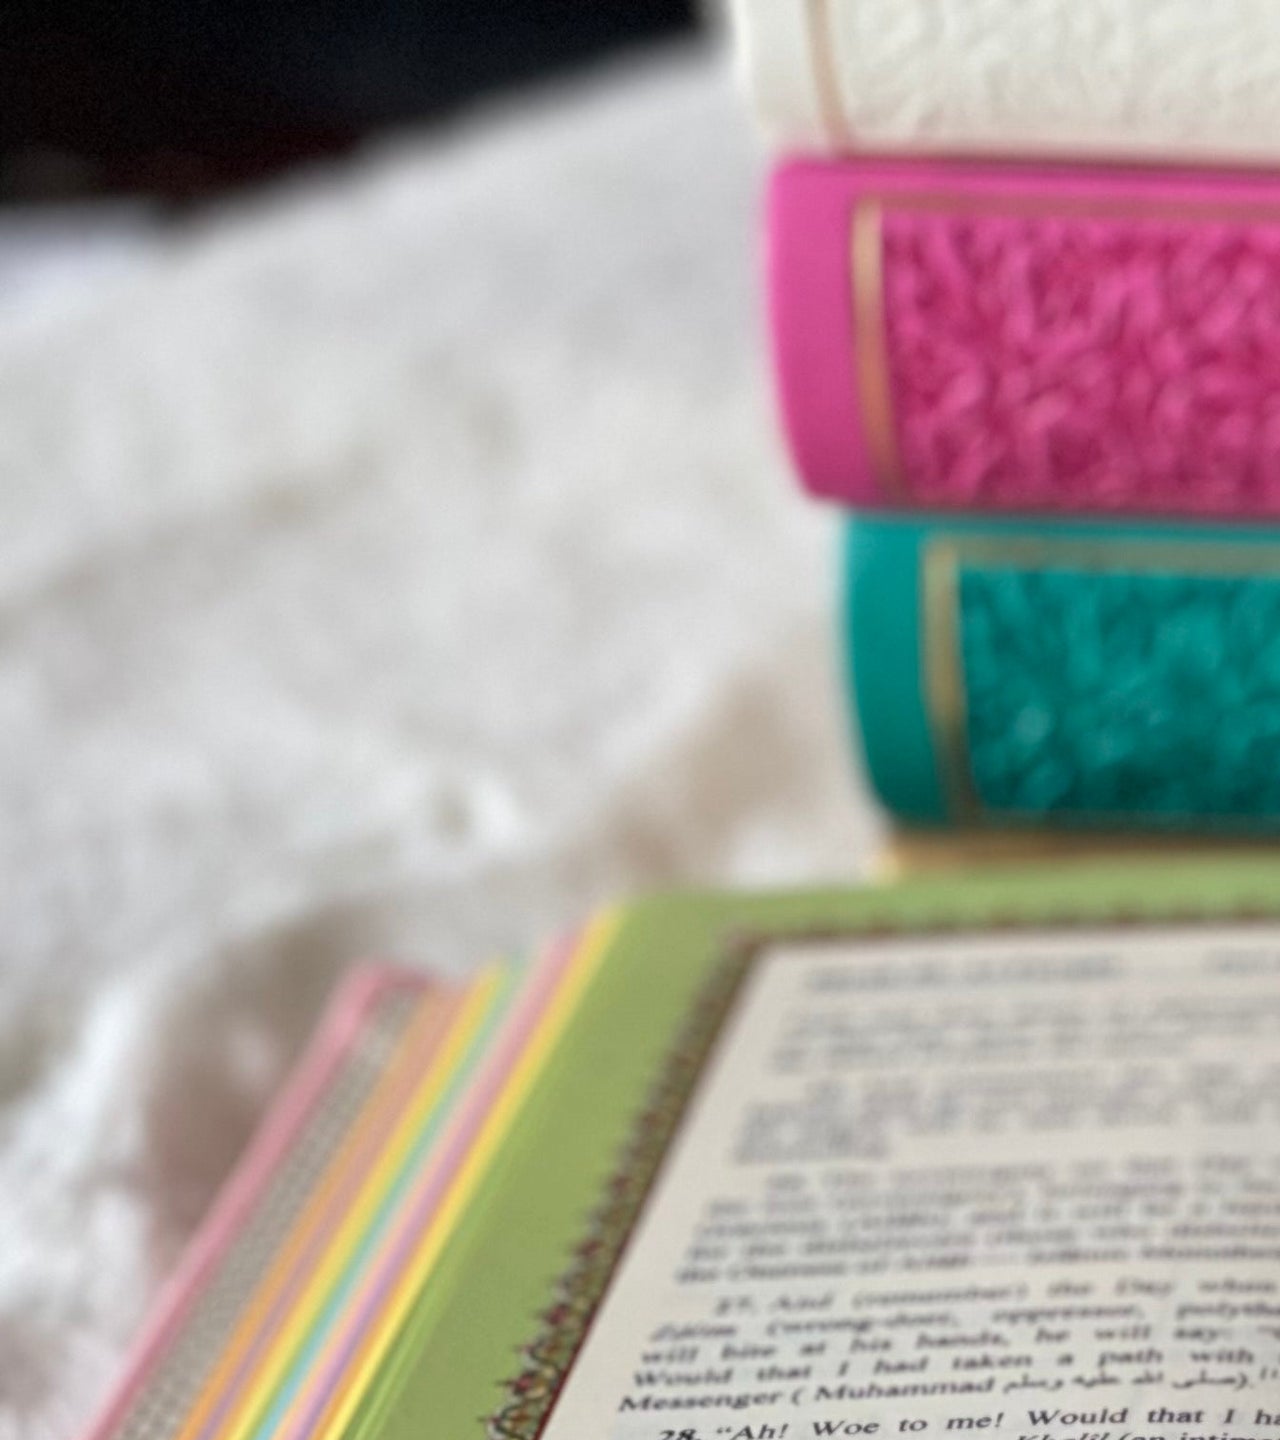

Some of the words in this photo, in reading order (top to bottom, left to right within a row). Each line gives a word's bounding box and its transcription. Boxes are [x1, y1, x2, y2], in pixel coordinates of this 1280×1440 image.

[812, 1420, 880, 1437] Woe
[898, 1419, 929, 1433] to
[945, 1412, 1005, 1431] me!
[1027, 1407, 1129, 1427] Would
[1146, 1407, 1204, 1424] that
[1223, 1408, 1236, 1425] I
